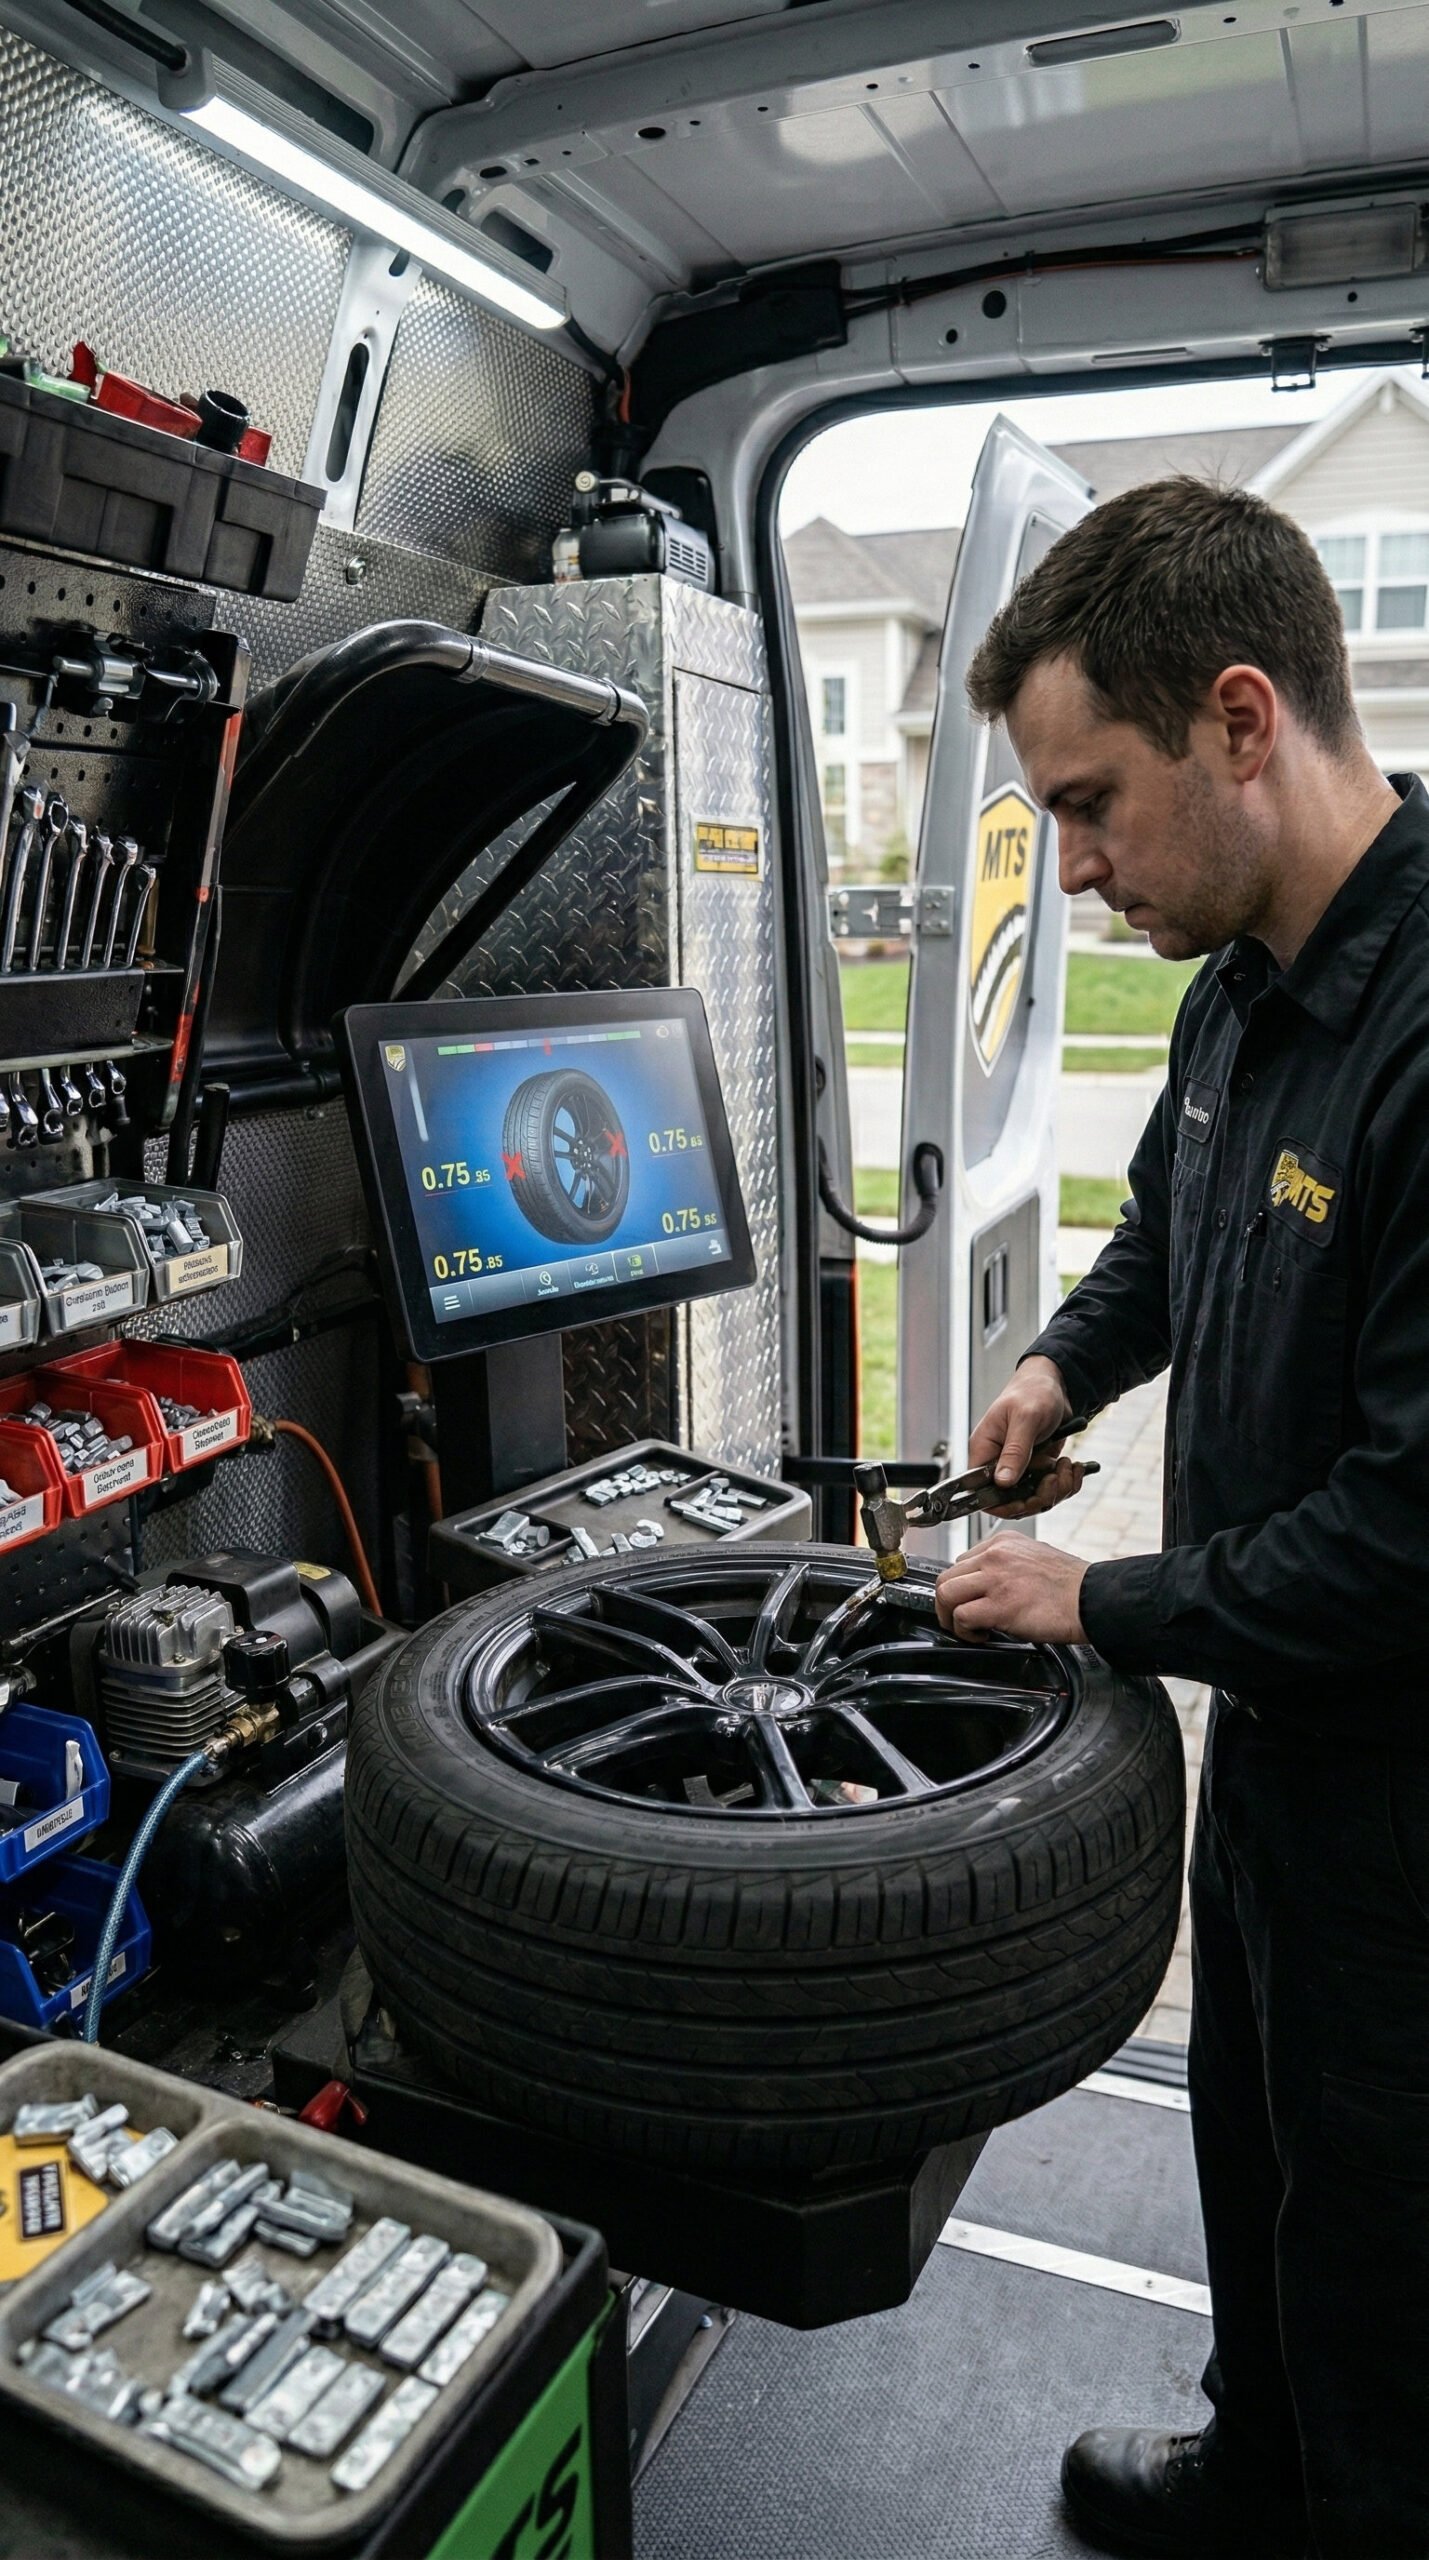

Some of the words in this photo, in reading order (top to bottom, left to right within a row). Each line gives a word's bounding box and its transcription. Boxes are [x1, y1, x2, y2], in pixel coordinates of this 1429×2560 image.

[982, 827, 1028, 882] MTS
[648, 1128, 687, 1153] 0.75
[421, 1161, 471, 1191] 0.75
[1284, 1167, 1336, 1223] MTS
[661, 1207, 701, 1234] 0.75
[433, 1248, 483, 1279] 0.75
